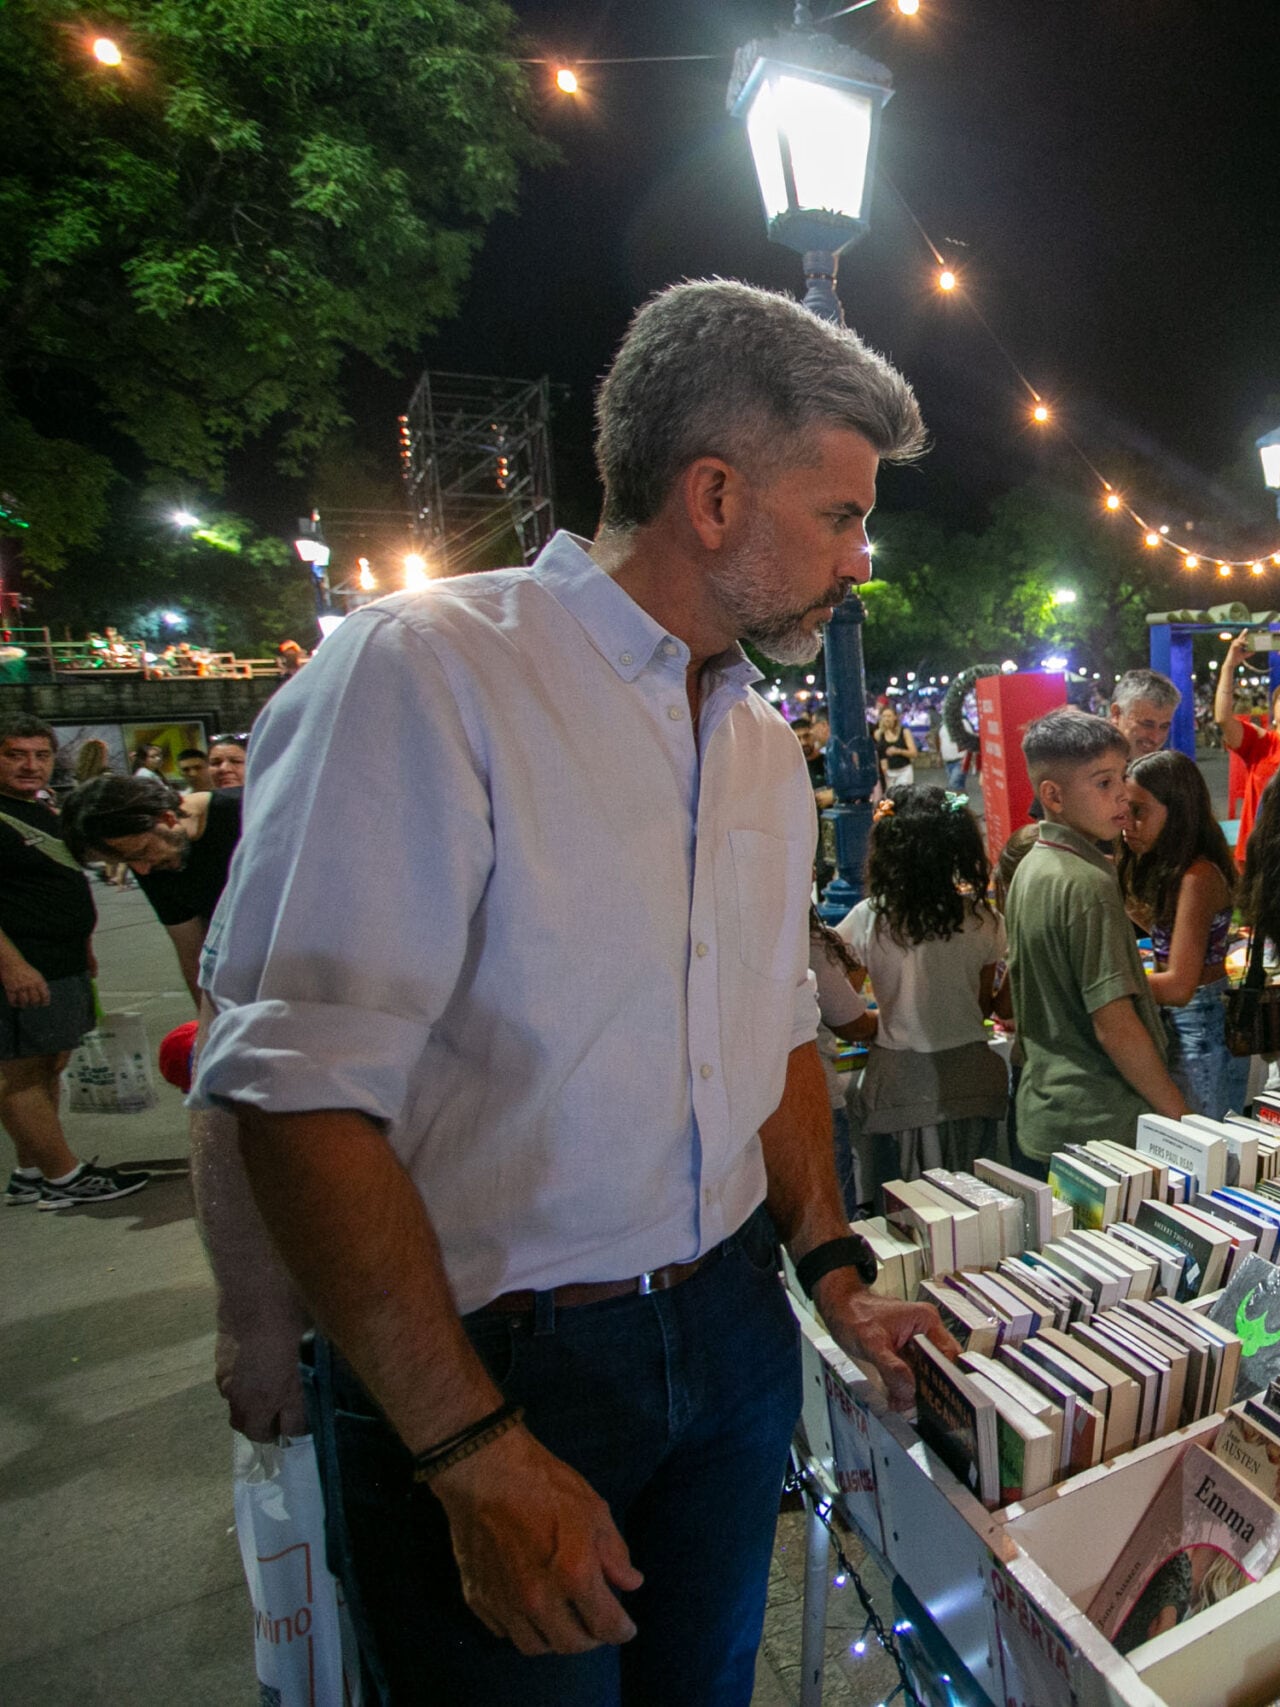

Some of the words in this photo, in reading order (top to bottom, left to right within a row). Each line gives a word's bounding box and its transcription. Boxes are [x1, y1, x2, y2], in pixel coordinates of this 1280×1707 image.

[1165, 1148, 1179, 1165] PAUL
[1181, 1155, 1194, 1171] READ
[1226, 1430, 1242, 1444] Jane
[1223, 1440, 1261, 1476] AUSTEN
[1193, 1474, 1256, 1543] Emma
[1115, 1560, 1142, 1597] Austen
[991, 1569, 1070, 1680] OFERTA
